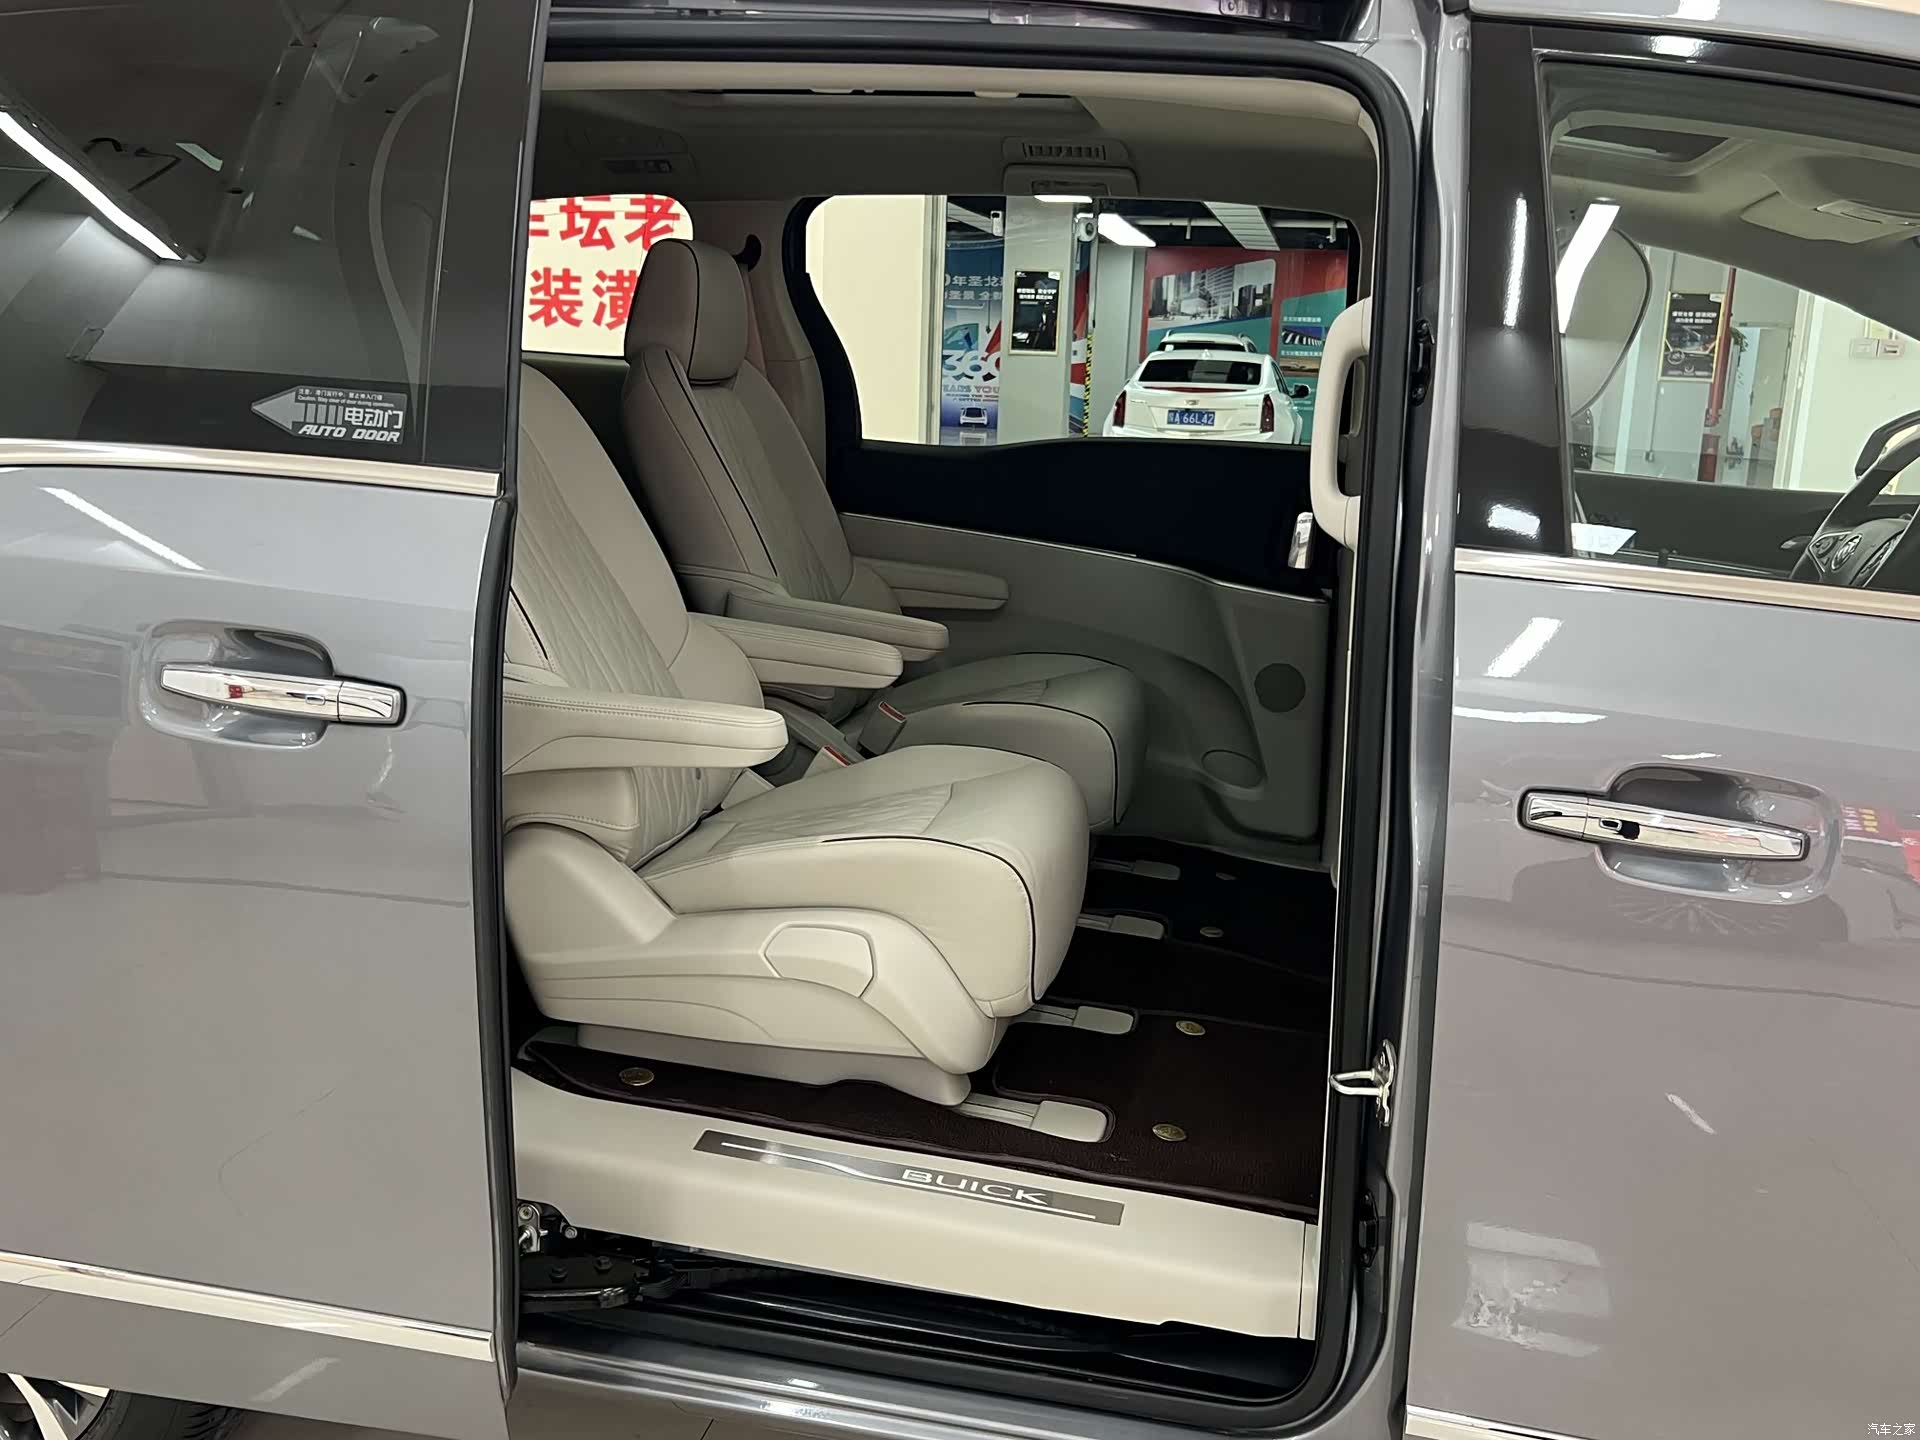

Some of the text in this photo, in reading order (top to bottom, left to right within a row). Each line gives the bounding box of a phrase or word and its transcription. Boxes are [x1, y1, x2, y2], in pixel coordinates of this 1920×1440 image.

[528, 267, 637, 331] 装潢
[344, 407, 403, 429] 电动门
[298, 424, 400, 443] AUTO DOOR
[901, 1168, 1049, 1206] BUICK
